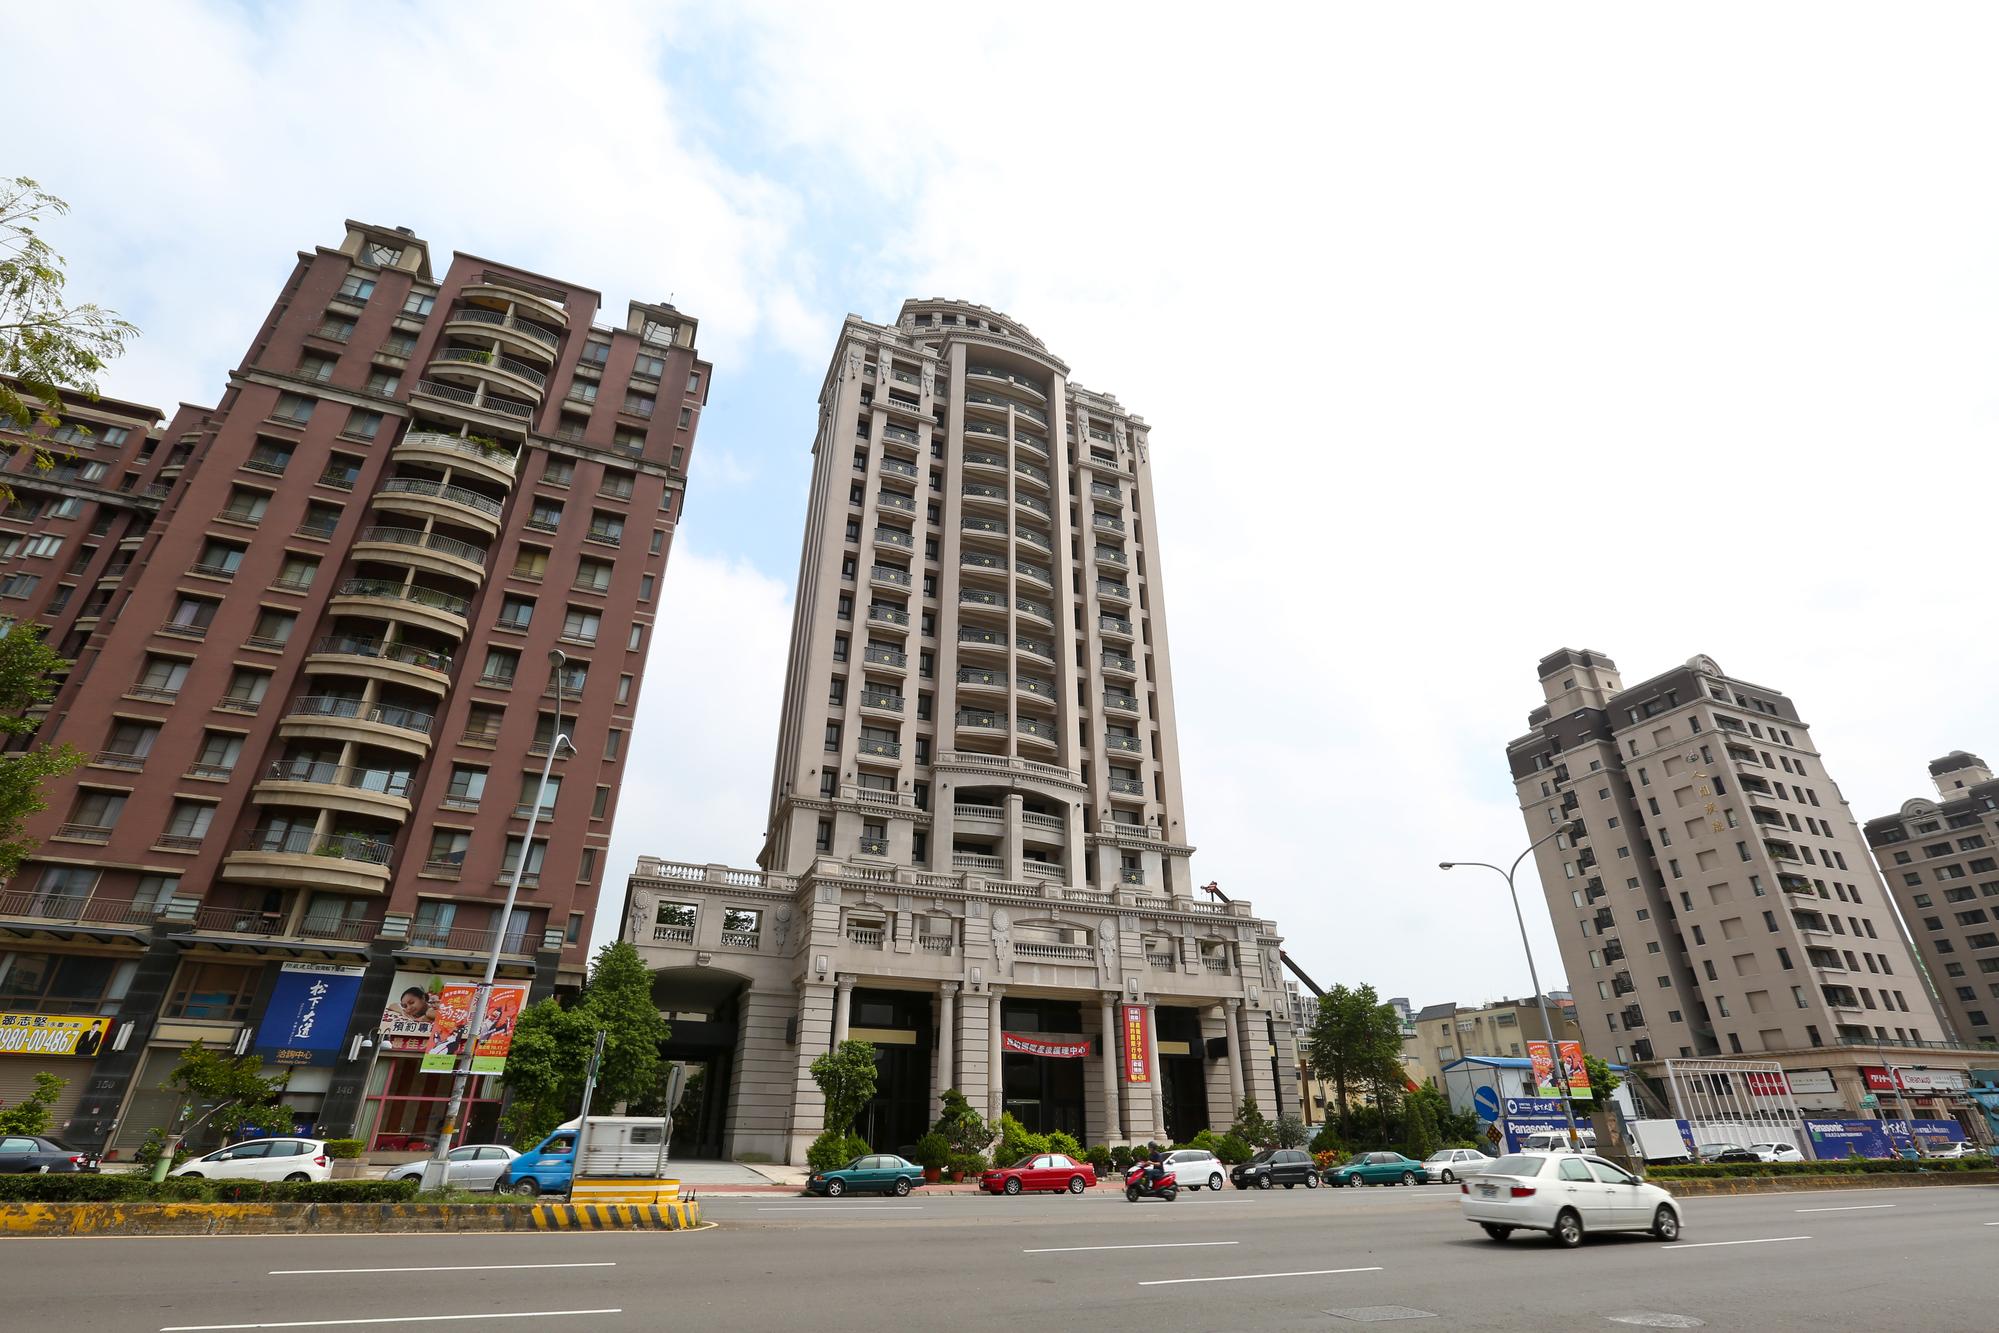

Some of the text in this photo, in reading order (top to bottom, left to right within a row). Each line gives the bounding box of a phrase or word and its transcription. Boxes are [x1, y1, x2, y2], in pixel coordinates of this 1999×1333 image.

[295, 979, 329, 1038] 松下大道
[392, 1021, 434, 1032] 預約專
[0, 1027, 80, 1053] 980-004867
[1507, 1121, 1554, 1135] Panasonic
[1807, 1121, 1845, 1133] Panasonic
